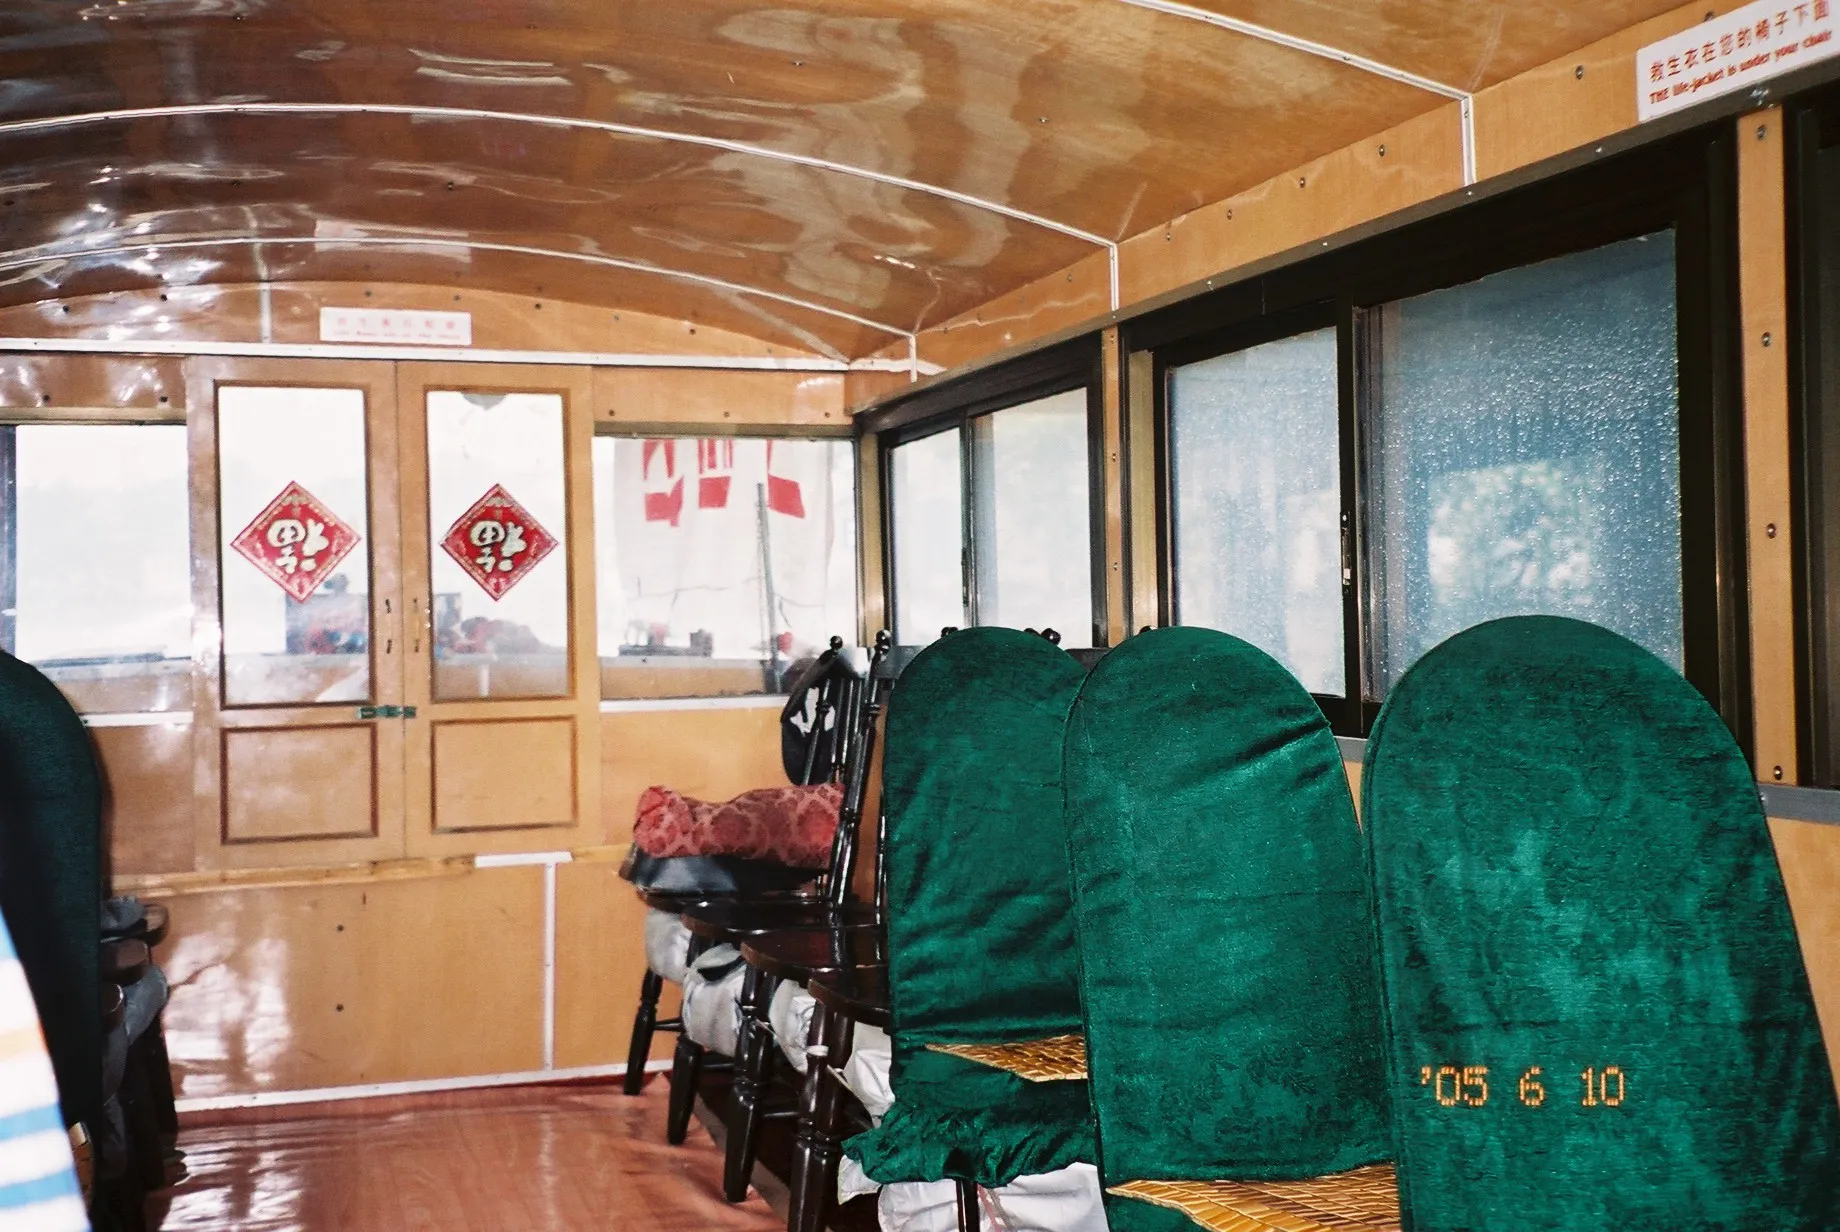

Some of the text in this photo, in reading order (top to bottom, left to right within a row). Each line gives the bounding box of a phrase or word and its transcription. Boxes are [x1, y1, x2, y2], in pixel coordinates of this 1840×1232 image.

[1649, 30, 1832, 104] THE life-jacket is under your chair
[266, 518, 329, 574] 福
[470, 519, 527, 573] 福
